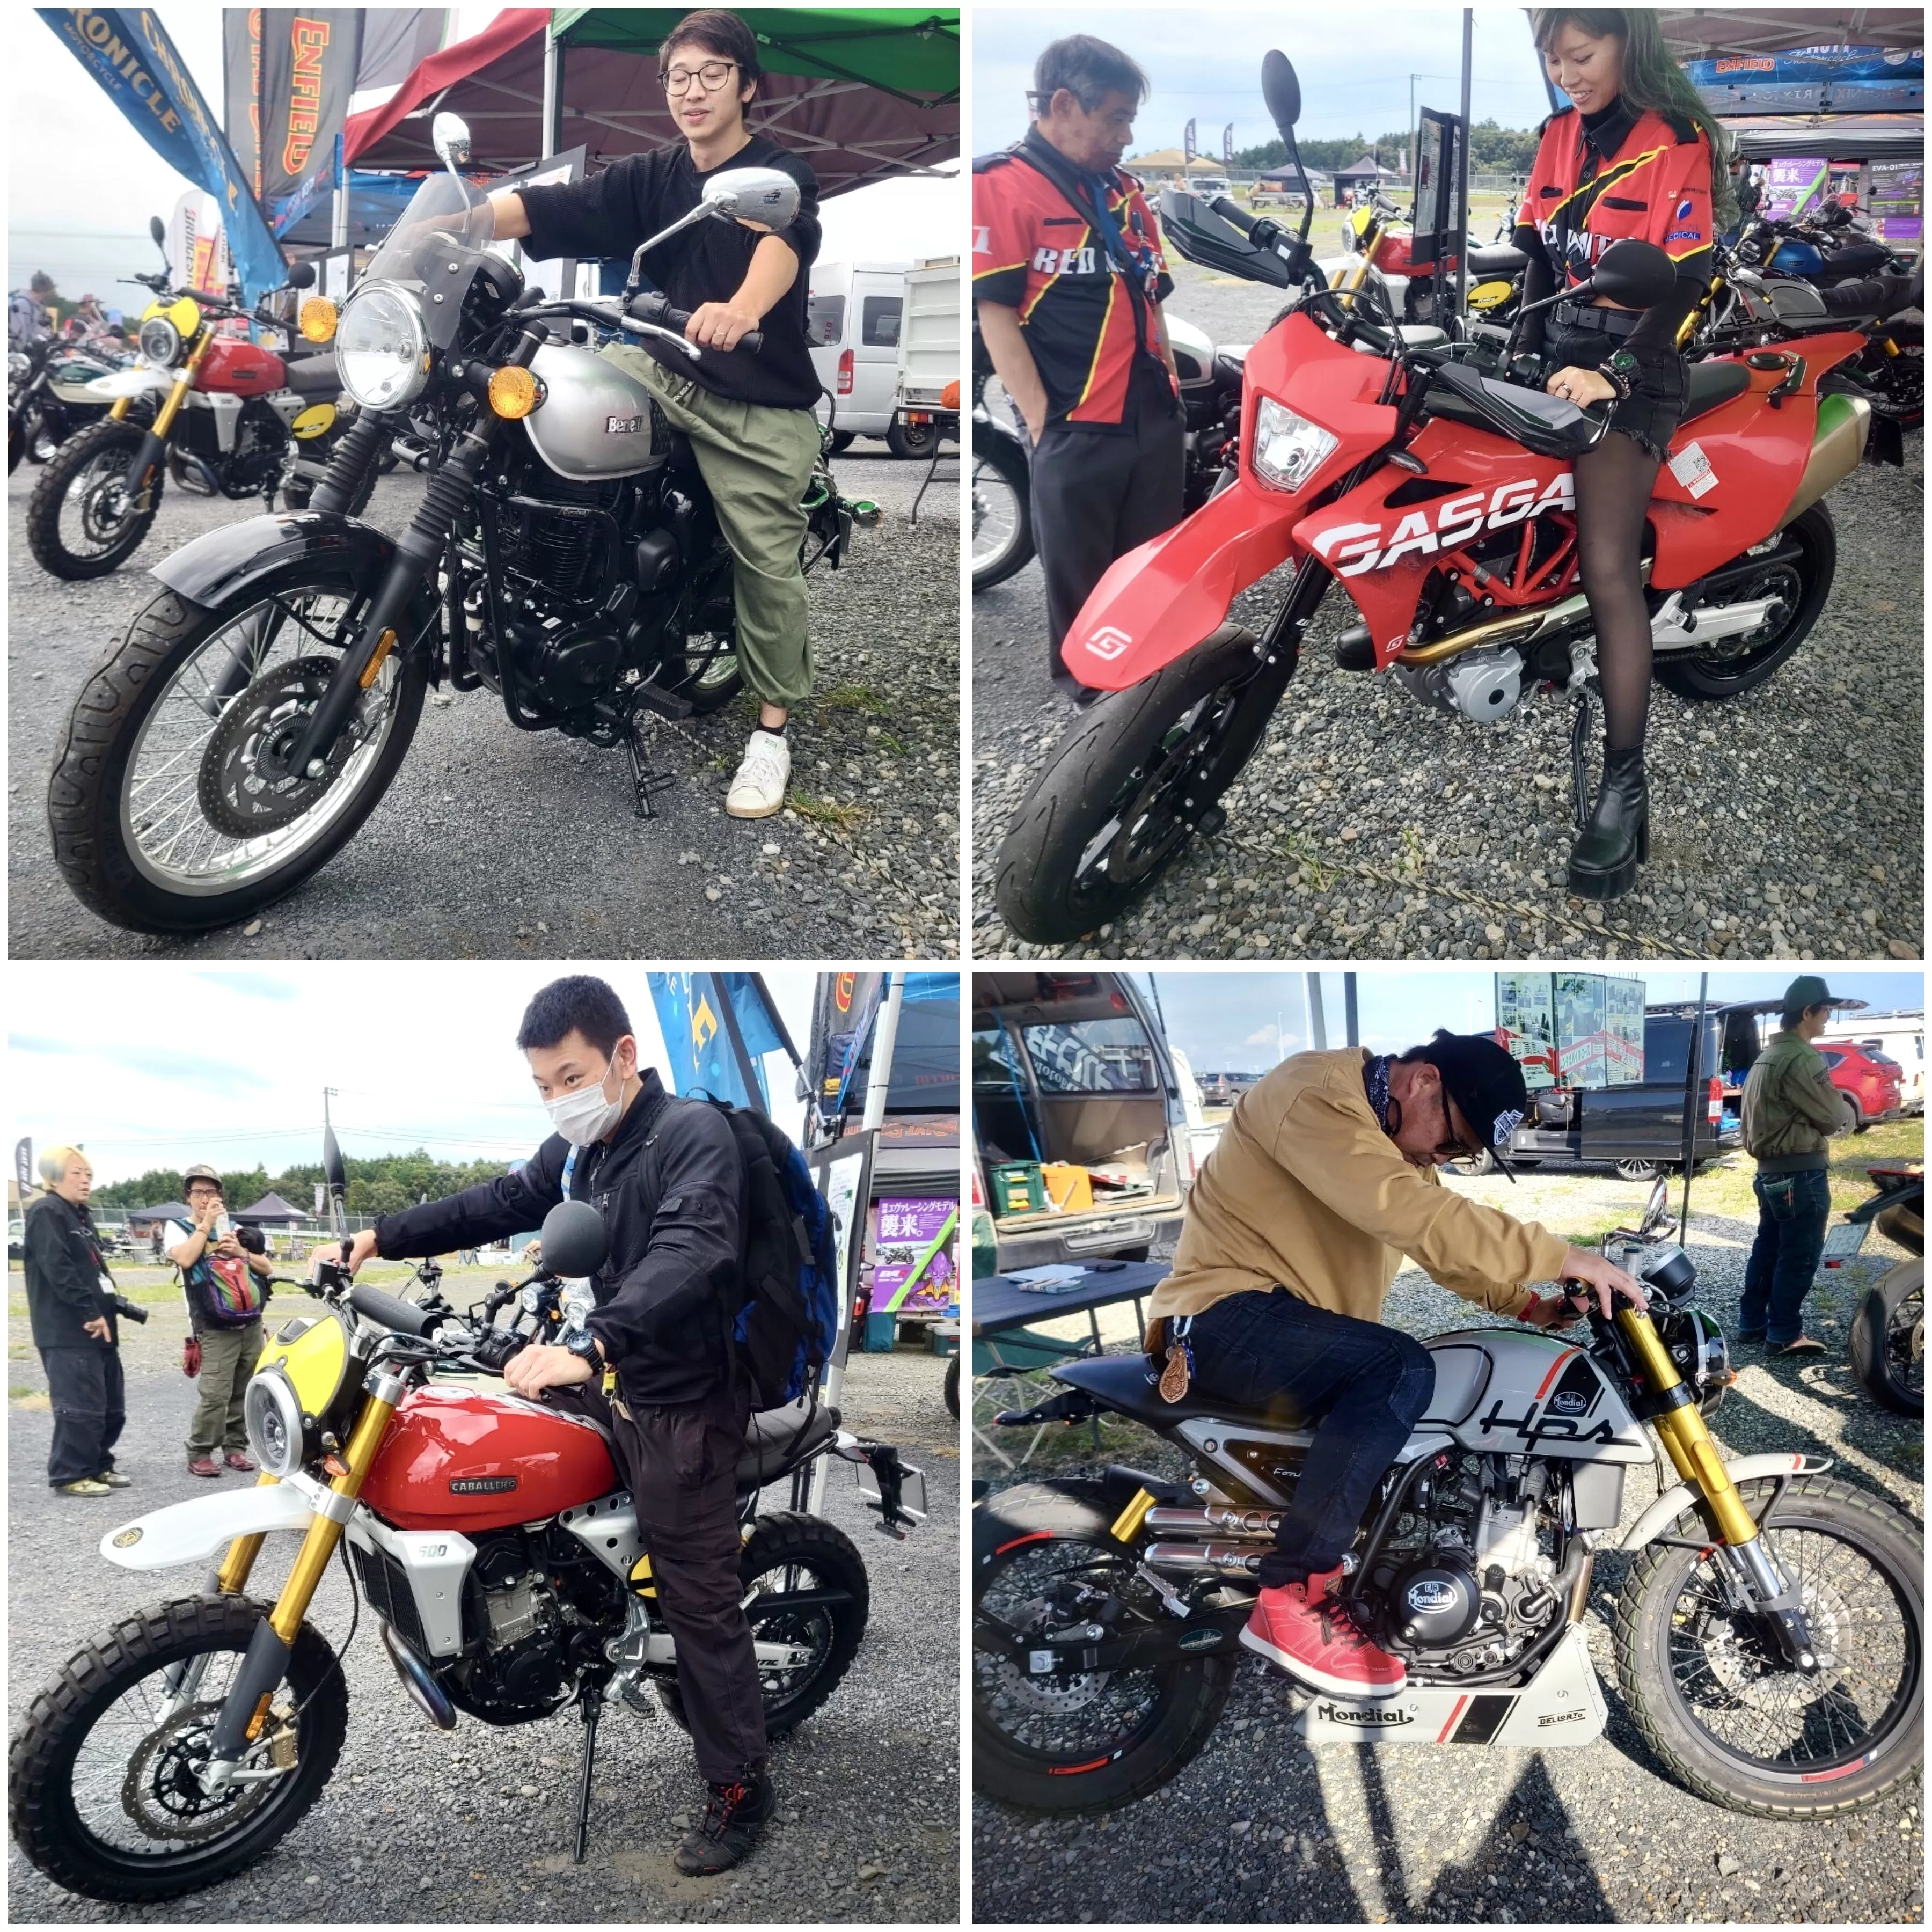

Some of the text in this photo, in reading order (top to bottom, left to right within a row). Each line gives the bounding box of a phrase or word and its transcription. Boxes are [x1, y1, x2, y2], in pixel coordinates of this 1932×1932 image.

[63, 21, 123, 90] MOTORCYCLE
[1715, 57, 1775, 73] ENFIELD
[282, 17, 330, 175] ENFIELD
[1033, 247, 1095, 275] RED
[881, 1213, 923, 1238] 襲来。
[1554, 1396, 1586, 1408] Mondial
[451, 1480, 516, 1491] CABALLERO
[419, 1545, 448, 1557] 500
[1407, 1590, 1458, 1605] Mondial
[1318, 1701, 1414, 1728] Mondial
